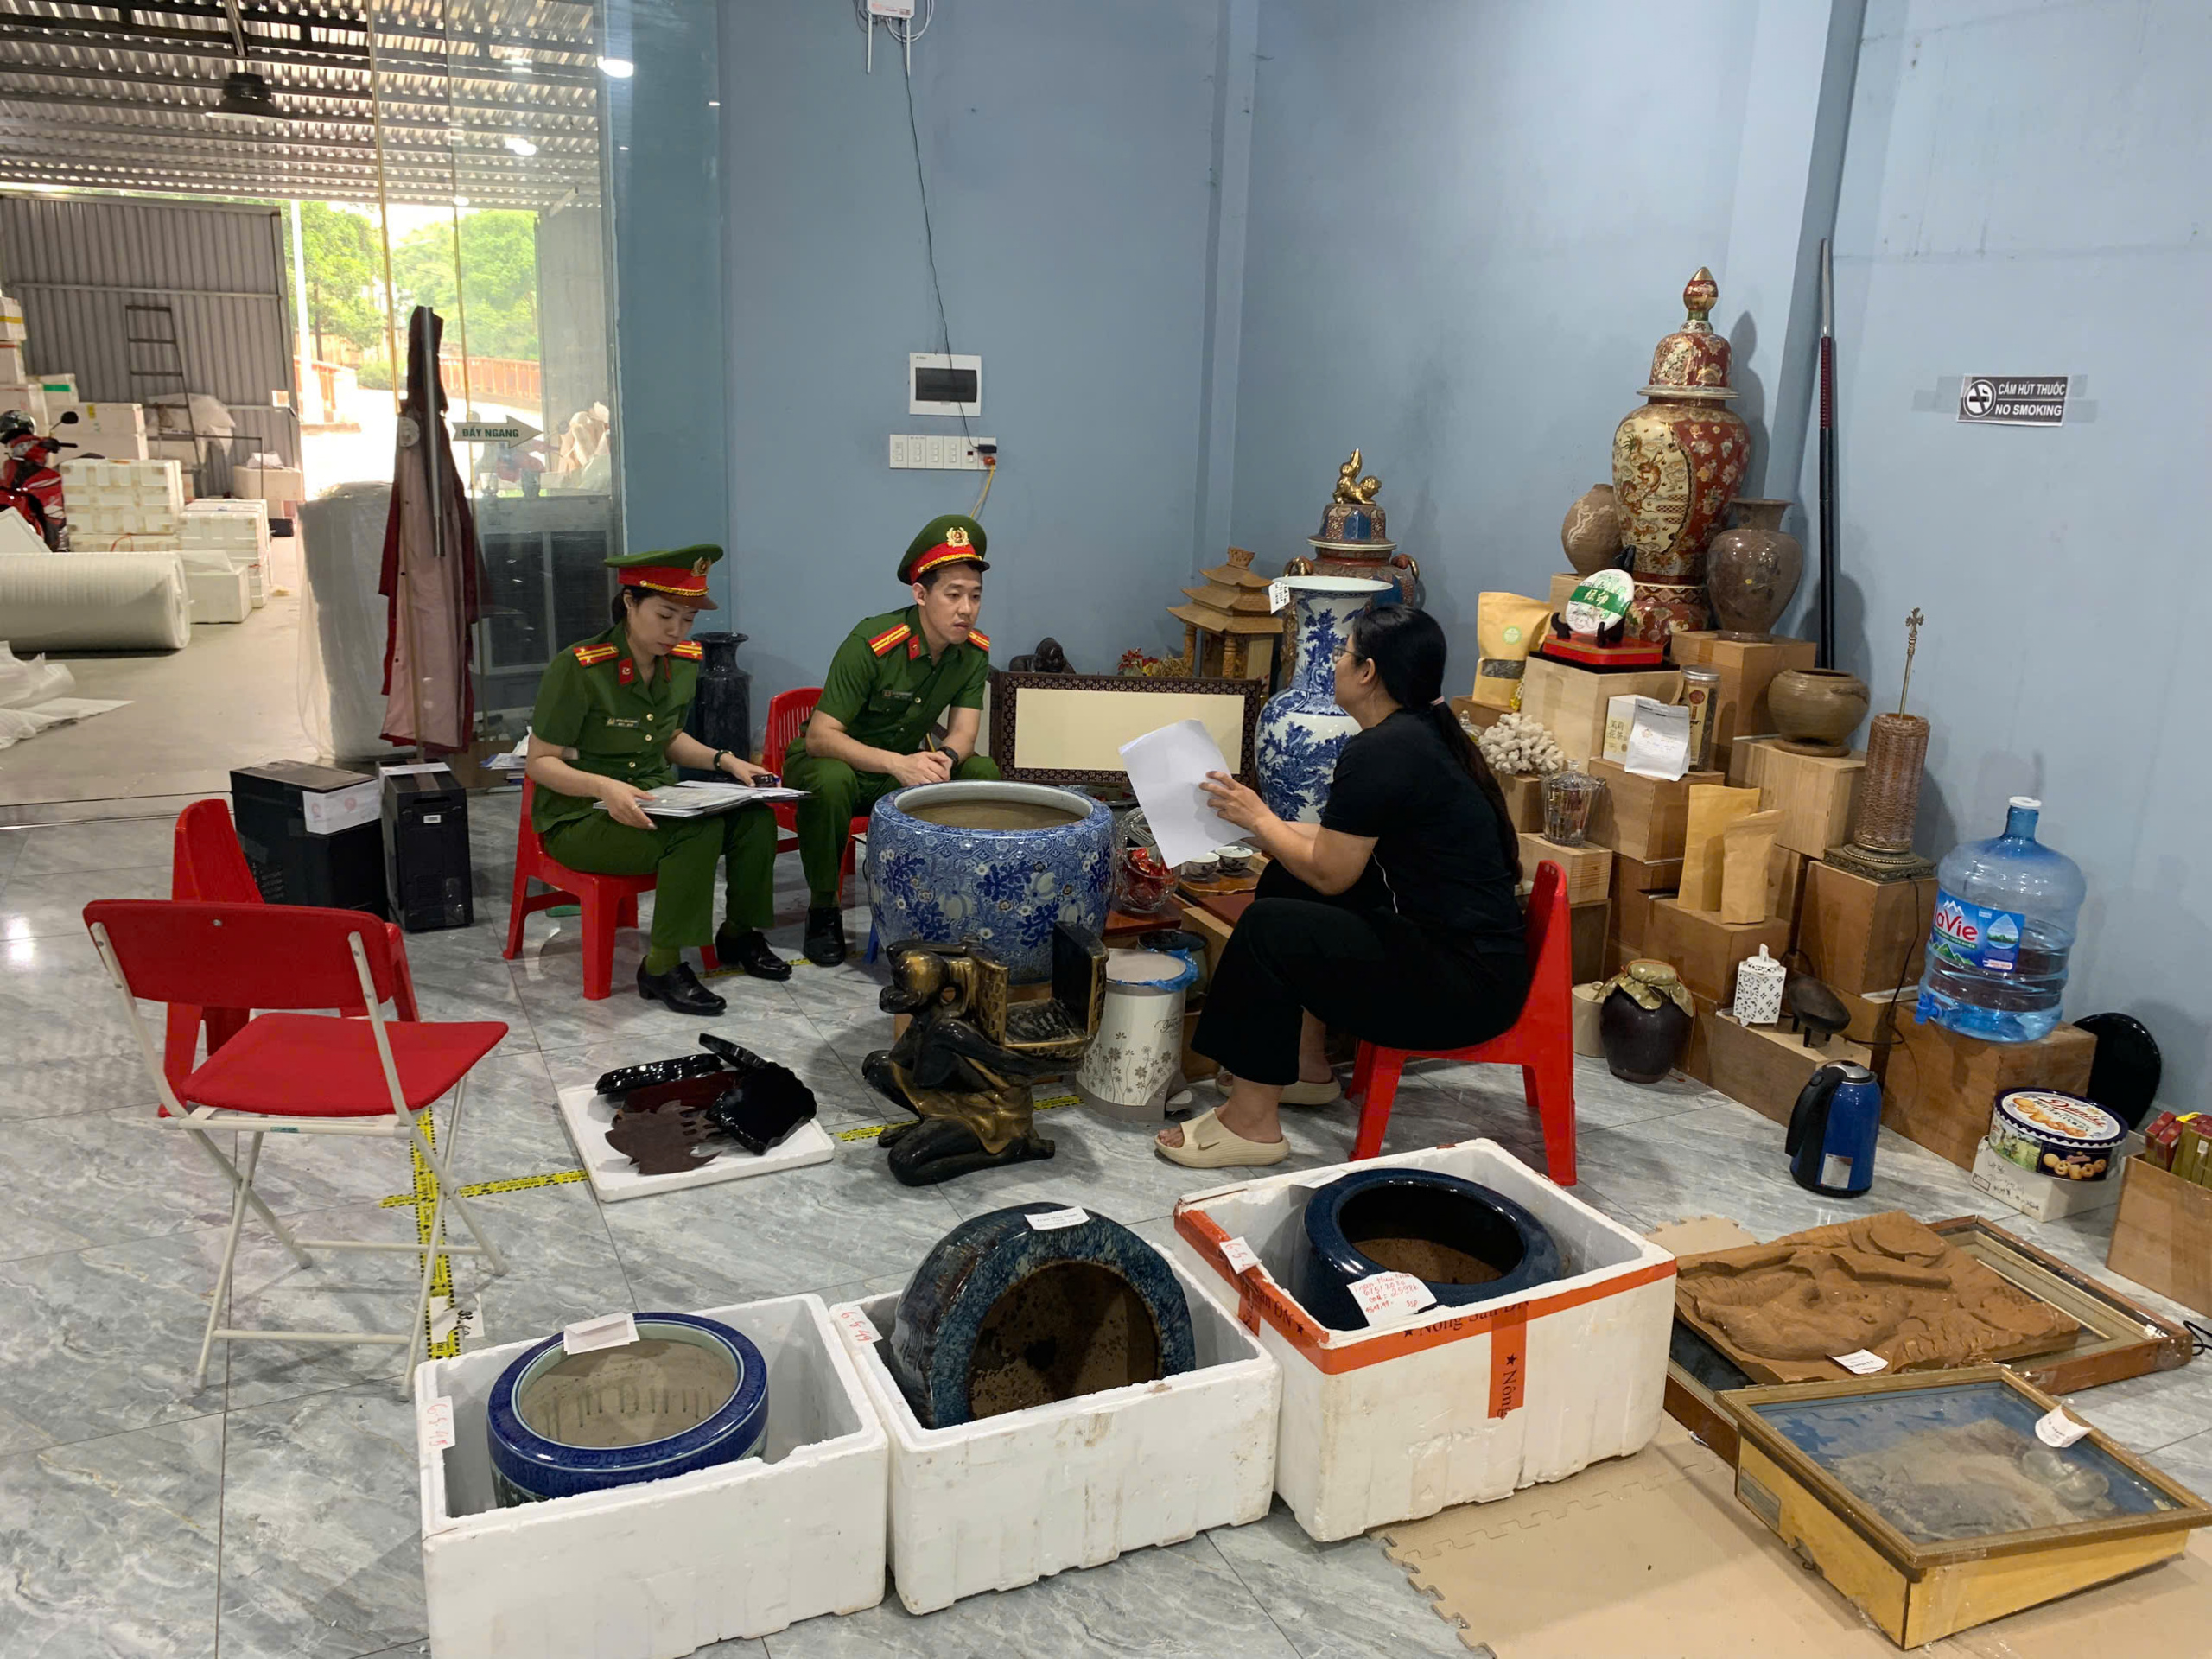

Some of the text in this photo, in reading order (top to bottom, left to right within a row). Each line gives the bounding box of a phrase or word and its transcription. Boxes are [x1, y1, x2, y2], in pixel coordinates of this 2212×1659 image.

[1998, 381, 2066, 396] CẤM HÚT THUỐC
[1994, 404, 2063, 416] NO SMOKING
[485, 429, 519, 438] NGANG
[1935, 909, 1979, 942] aVie
